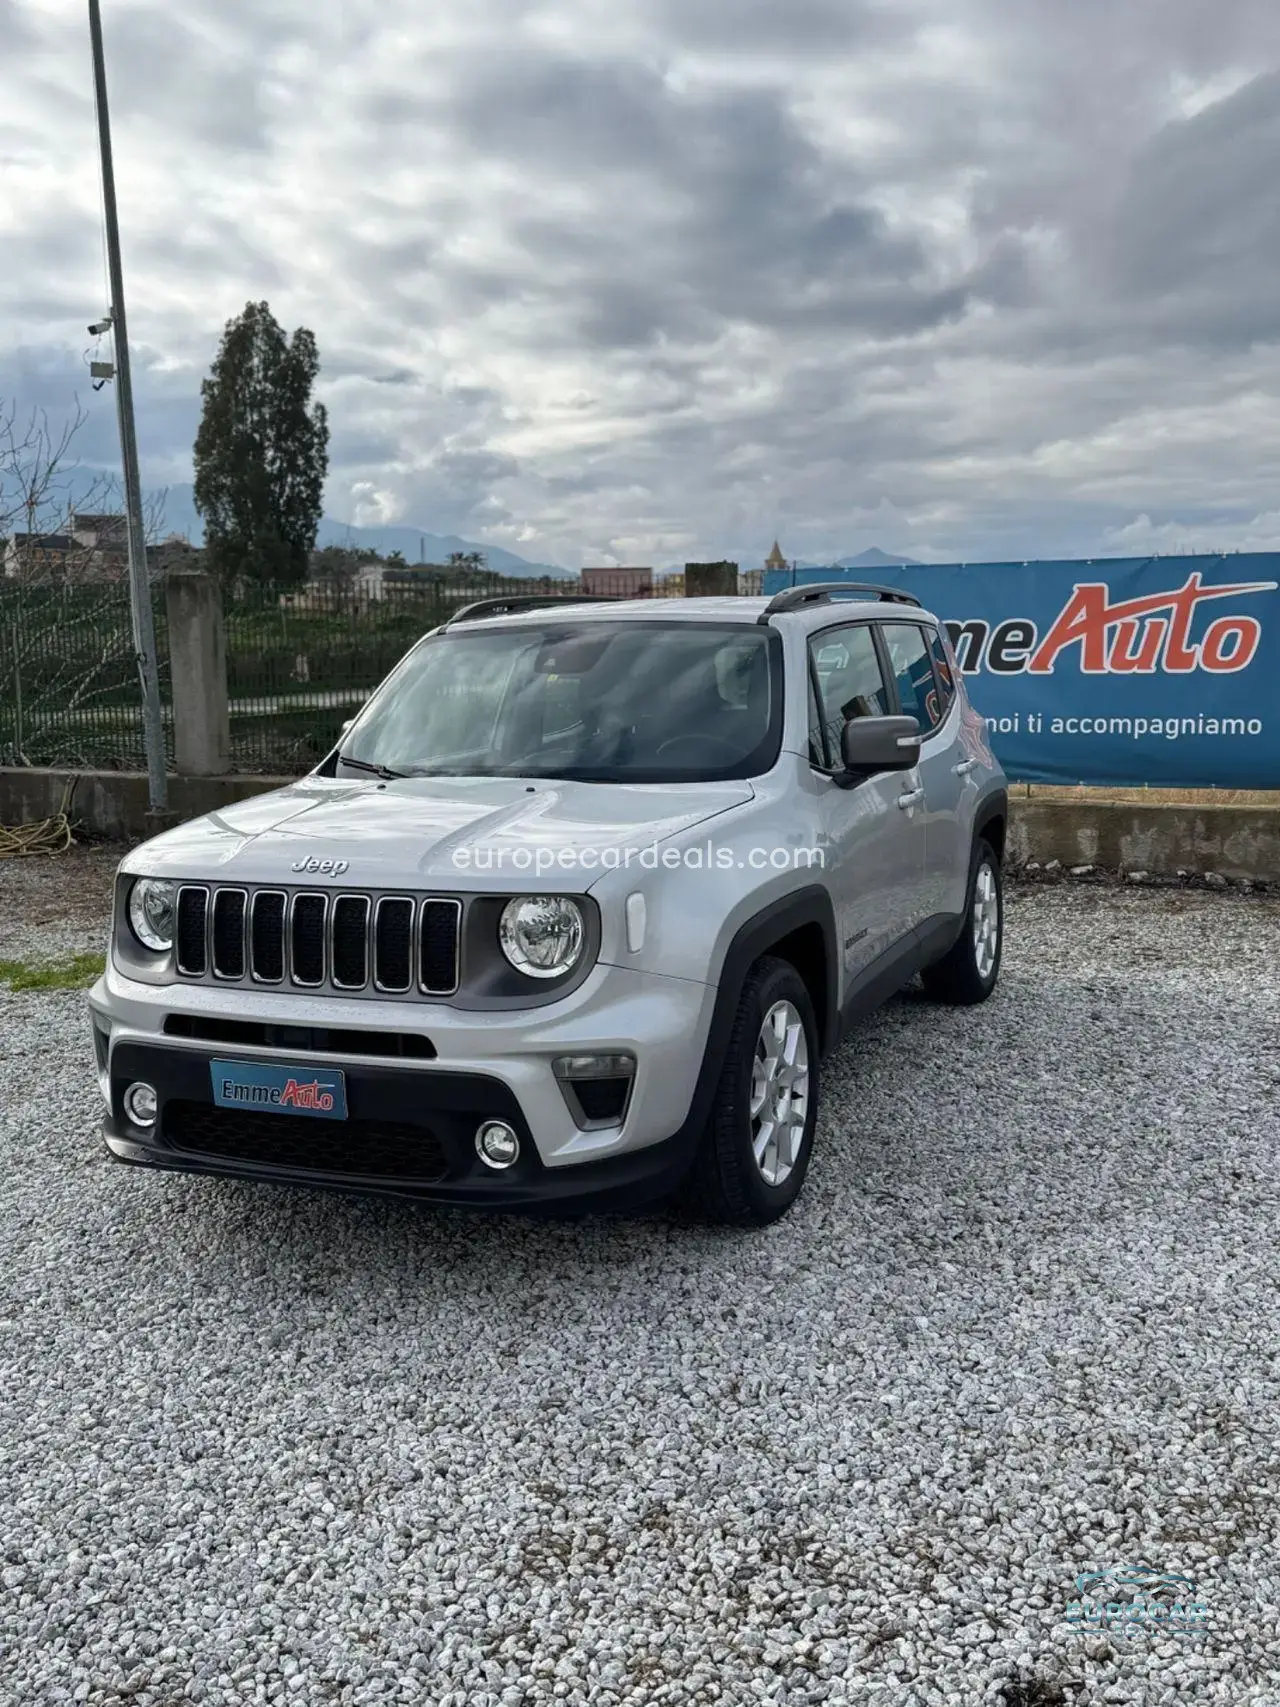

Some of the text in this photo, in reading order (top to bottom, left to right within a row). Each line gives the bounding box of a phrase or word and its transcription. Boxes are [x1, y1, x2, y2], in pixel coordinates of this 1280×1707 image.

[985, 713, 1262, 740] noi ti accompagniamo
[291, 855, 350, 878] Jeep
[221, 1078, 336, 1111] EmmeAuto
